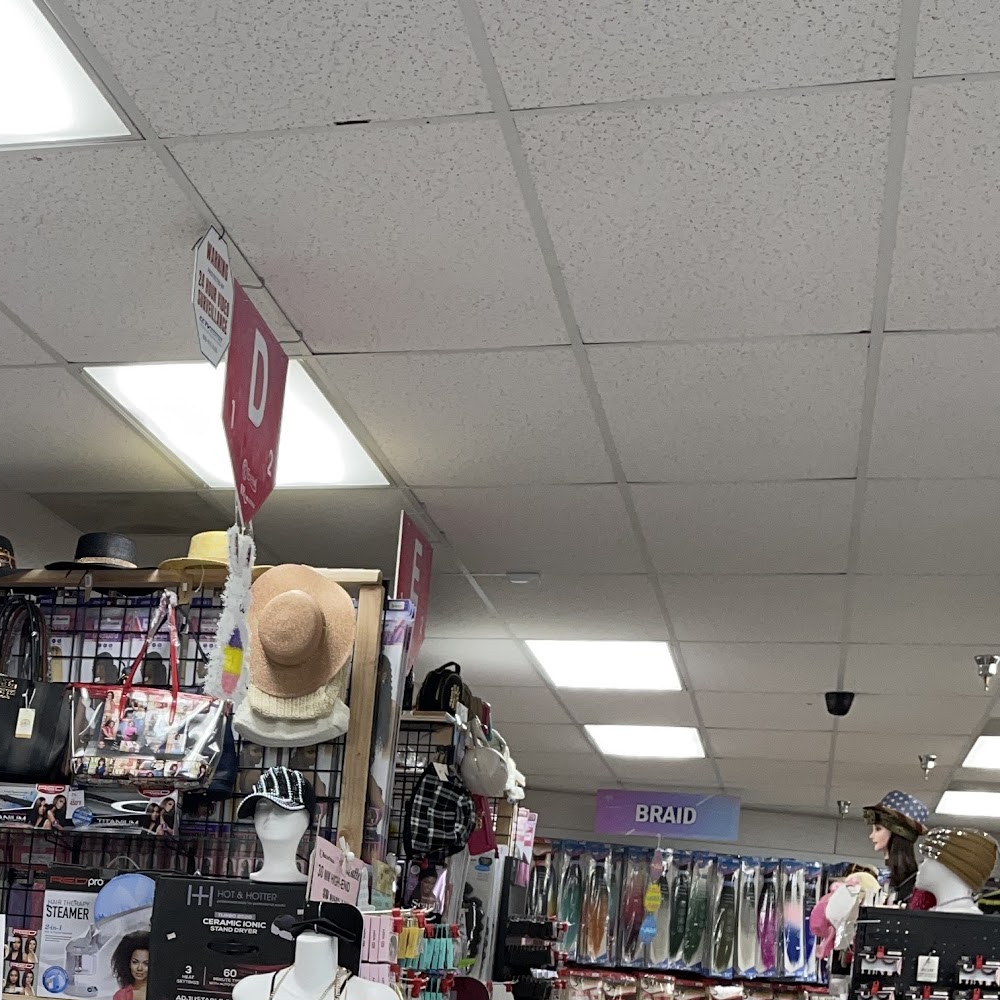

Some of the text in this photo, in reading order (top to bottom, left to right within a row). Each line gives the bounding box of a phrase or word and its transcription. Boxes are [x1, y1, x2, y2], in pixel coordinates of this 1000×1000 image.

[248, 328, 268, 428] D
[635, 803, 697, 826] BRAID
[97, 817, 139, 826] TITANIUM
[217, 890, 235, 899] HOT
[245, 891, 278, 901] HOTTER
[46, 905, 90, 920] STEAMER
[202, 918, 267, 929] CERAMIC IONIC
[210, 925, 258, 935] STAND DRYER
[185, 965, 192, 974] 3
[223, 968, 237, 977] 60
